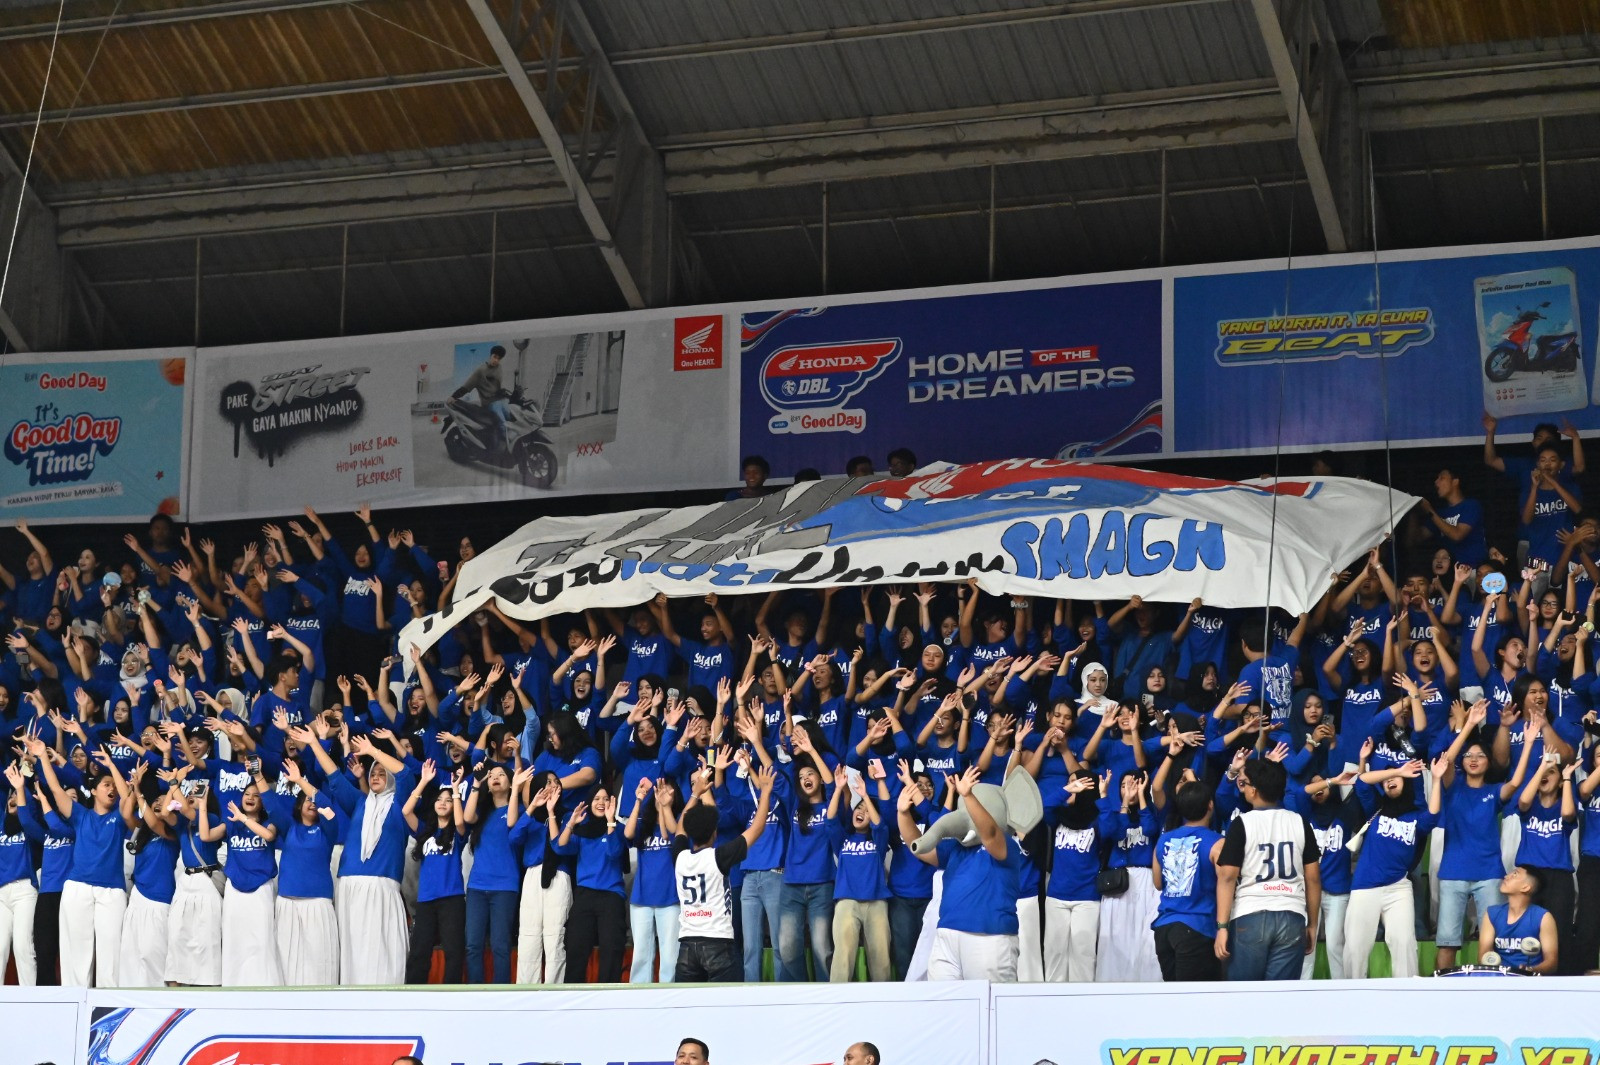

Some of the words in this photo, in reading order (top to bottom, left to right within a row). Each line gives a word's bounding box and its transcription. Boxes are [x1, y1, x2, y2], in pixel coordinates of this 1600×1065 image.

[1219, 321, 1264, 336] YANG
[1268, 316, 1329, 333] WORTH
[1355, 312, 1377, 326] YA
[1380, 309, 1429, 324] CUMA
[798, 356, 867, 370] HONDA
[908, 348, 1024, 377] HOME
[1038, 352, 1057, 362] OF
[1062, 350, 1091, 360] THE
[40, 372, 76, 390] Good
[78, 372, 106, 392] Day
[226, 394, 248, 410] PAKE
[252, 366, 371, 412] STREET
[797, 378, 831, 395] DBL
[908, 366, 1135, 404] DREAMERS
[12, 416, 73, 454] Good
[74, 414, 120, 444] Day
[253, 415, 276, 432] GAYA
[280, 408, 312, 428] MAKIN
[33, 443, 98, 476] Time!
[230, 835, 268, 848] SMAGA
[1256, 841, 1298, 883] 30
[682, 873, 706, 905] 51
[1494, 937, 1522, 950] SMAG
